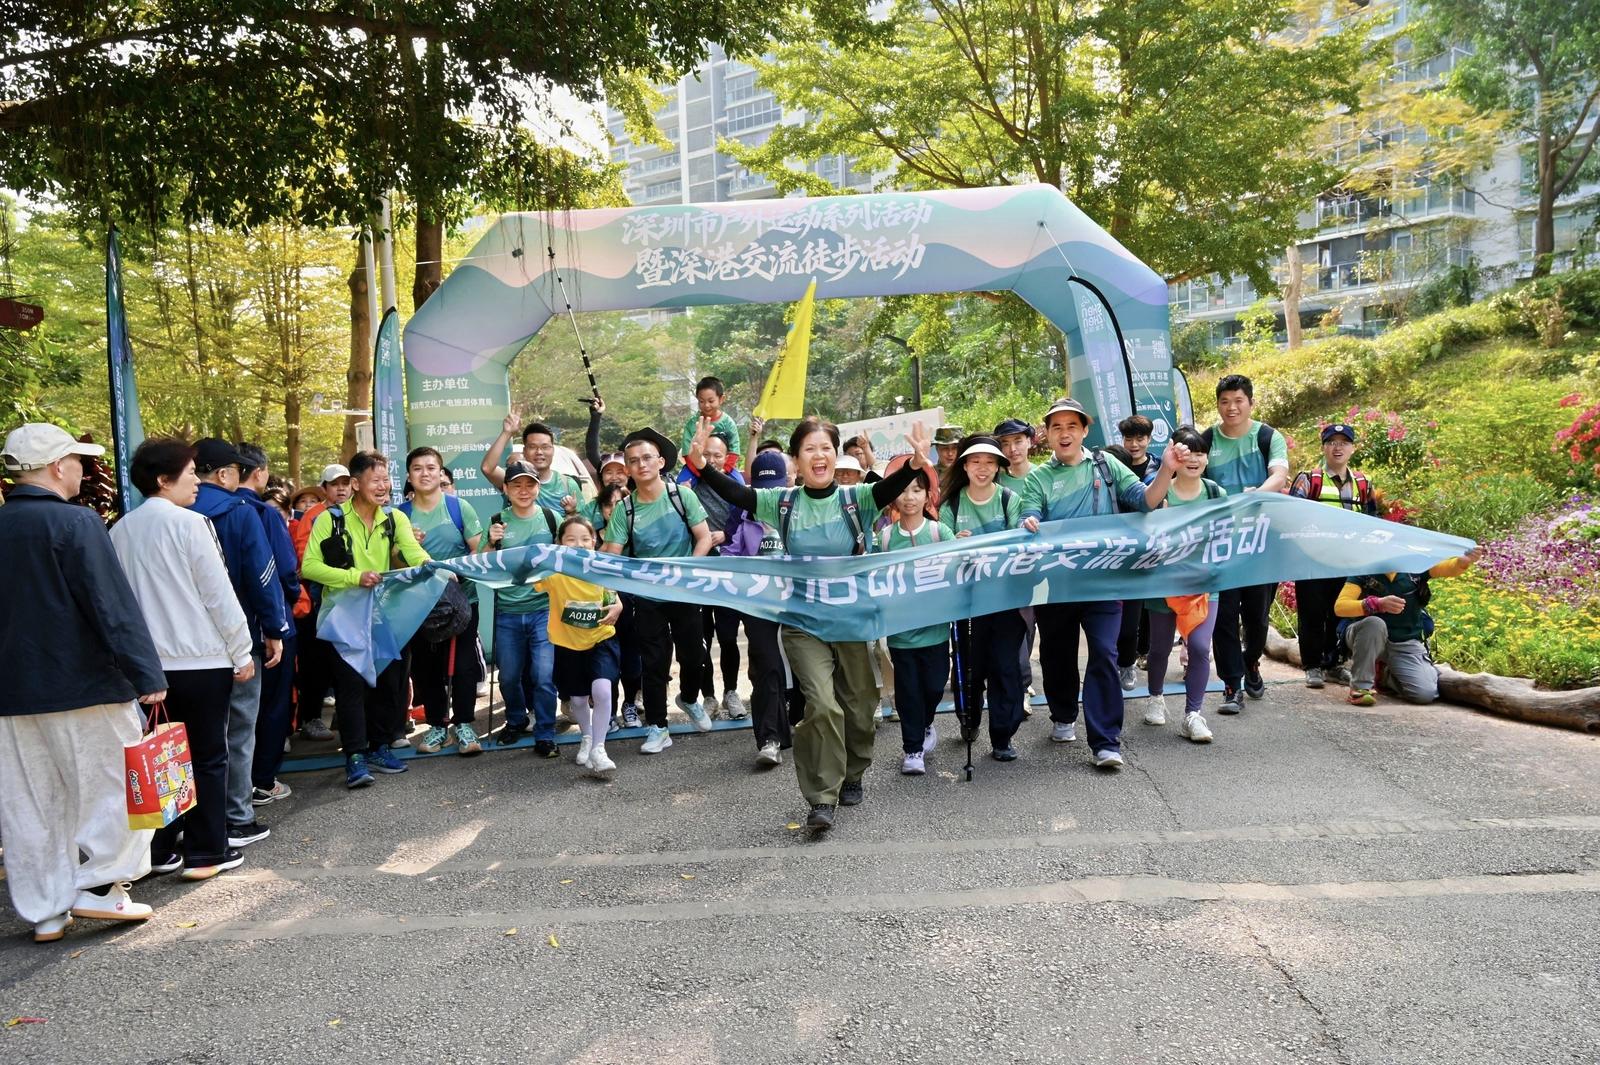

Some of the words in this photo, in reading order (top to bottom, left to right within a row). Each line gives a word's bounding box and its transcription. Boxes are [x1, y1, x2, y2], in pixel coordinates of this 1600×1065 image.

[622, 199, 934, 246] 深圳市户外运动系列活动
[636, 233, 926, 290] 暨深港交流徒步活动
[422, 377, 469, 391] 主办单位
[426, 422, 473, 437] 承办单位
[569, 611, 597, 621] A0184
